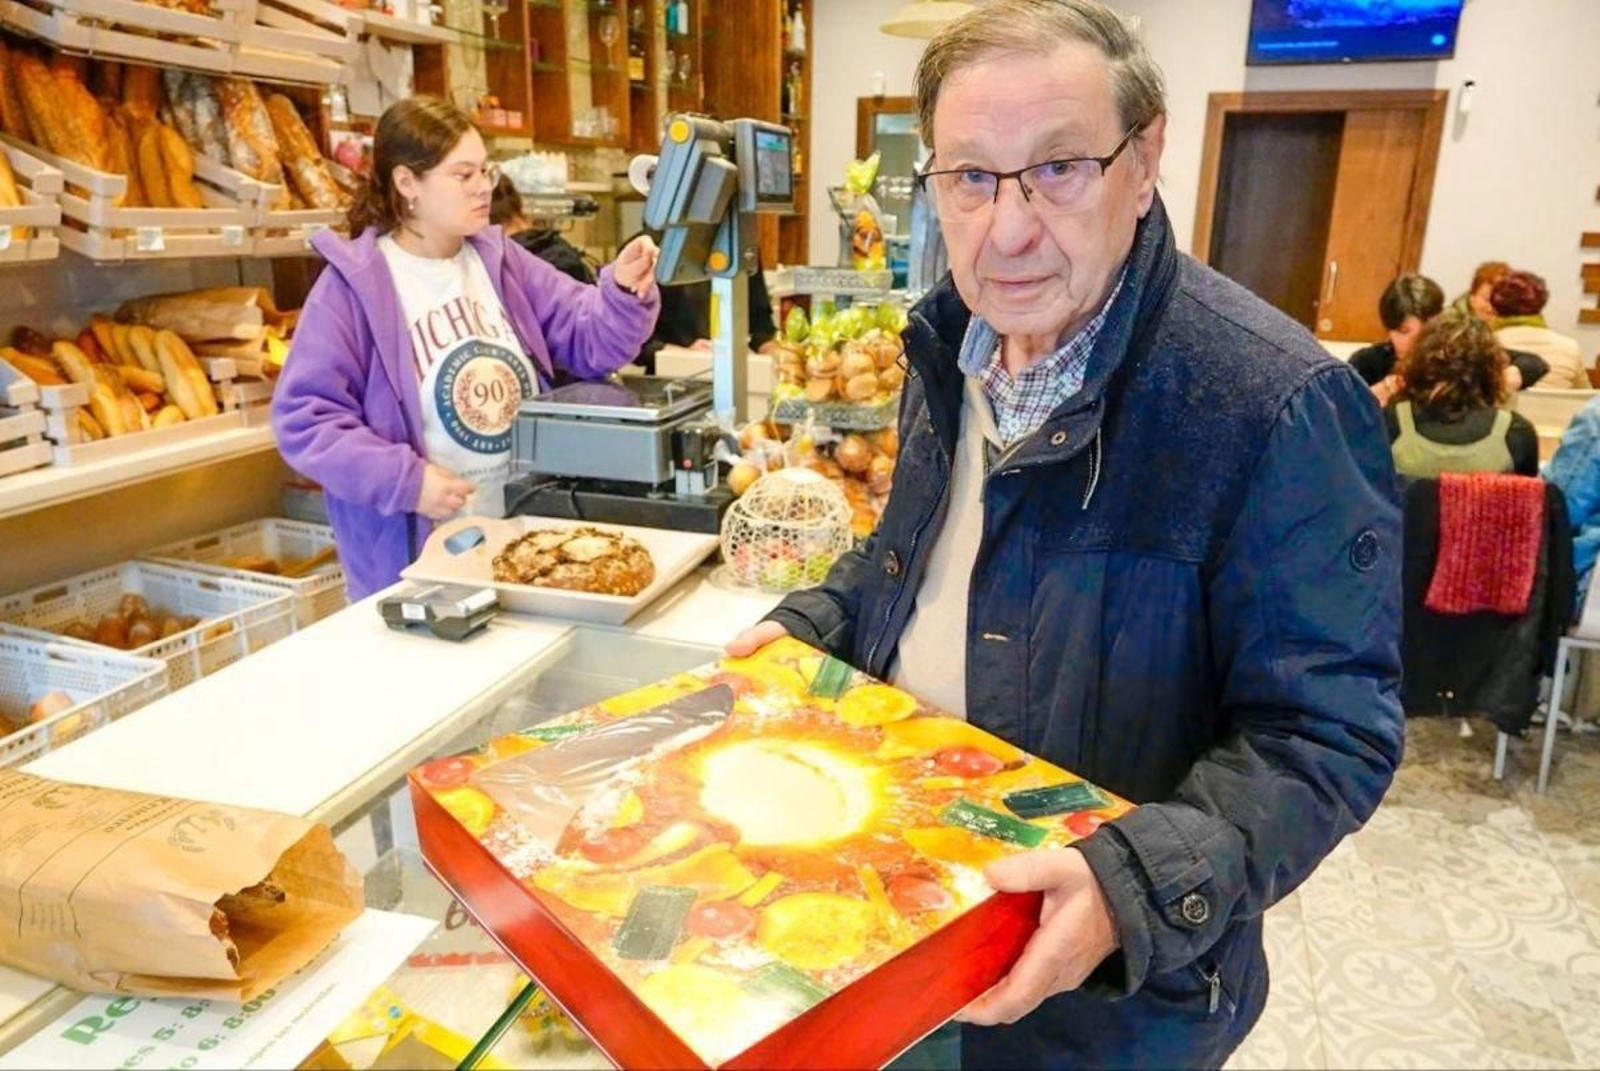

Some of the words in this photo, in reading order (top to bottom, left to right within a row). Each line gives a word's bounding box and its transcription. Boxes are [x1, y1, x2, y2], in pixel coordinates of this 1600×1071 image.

[473, 379, 505, 407] 90
[61, 995, 142, 1046] Re
[197, 1033, 227, 1051] 6:
